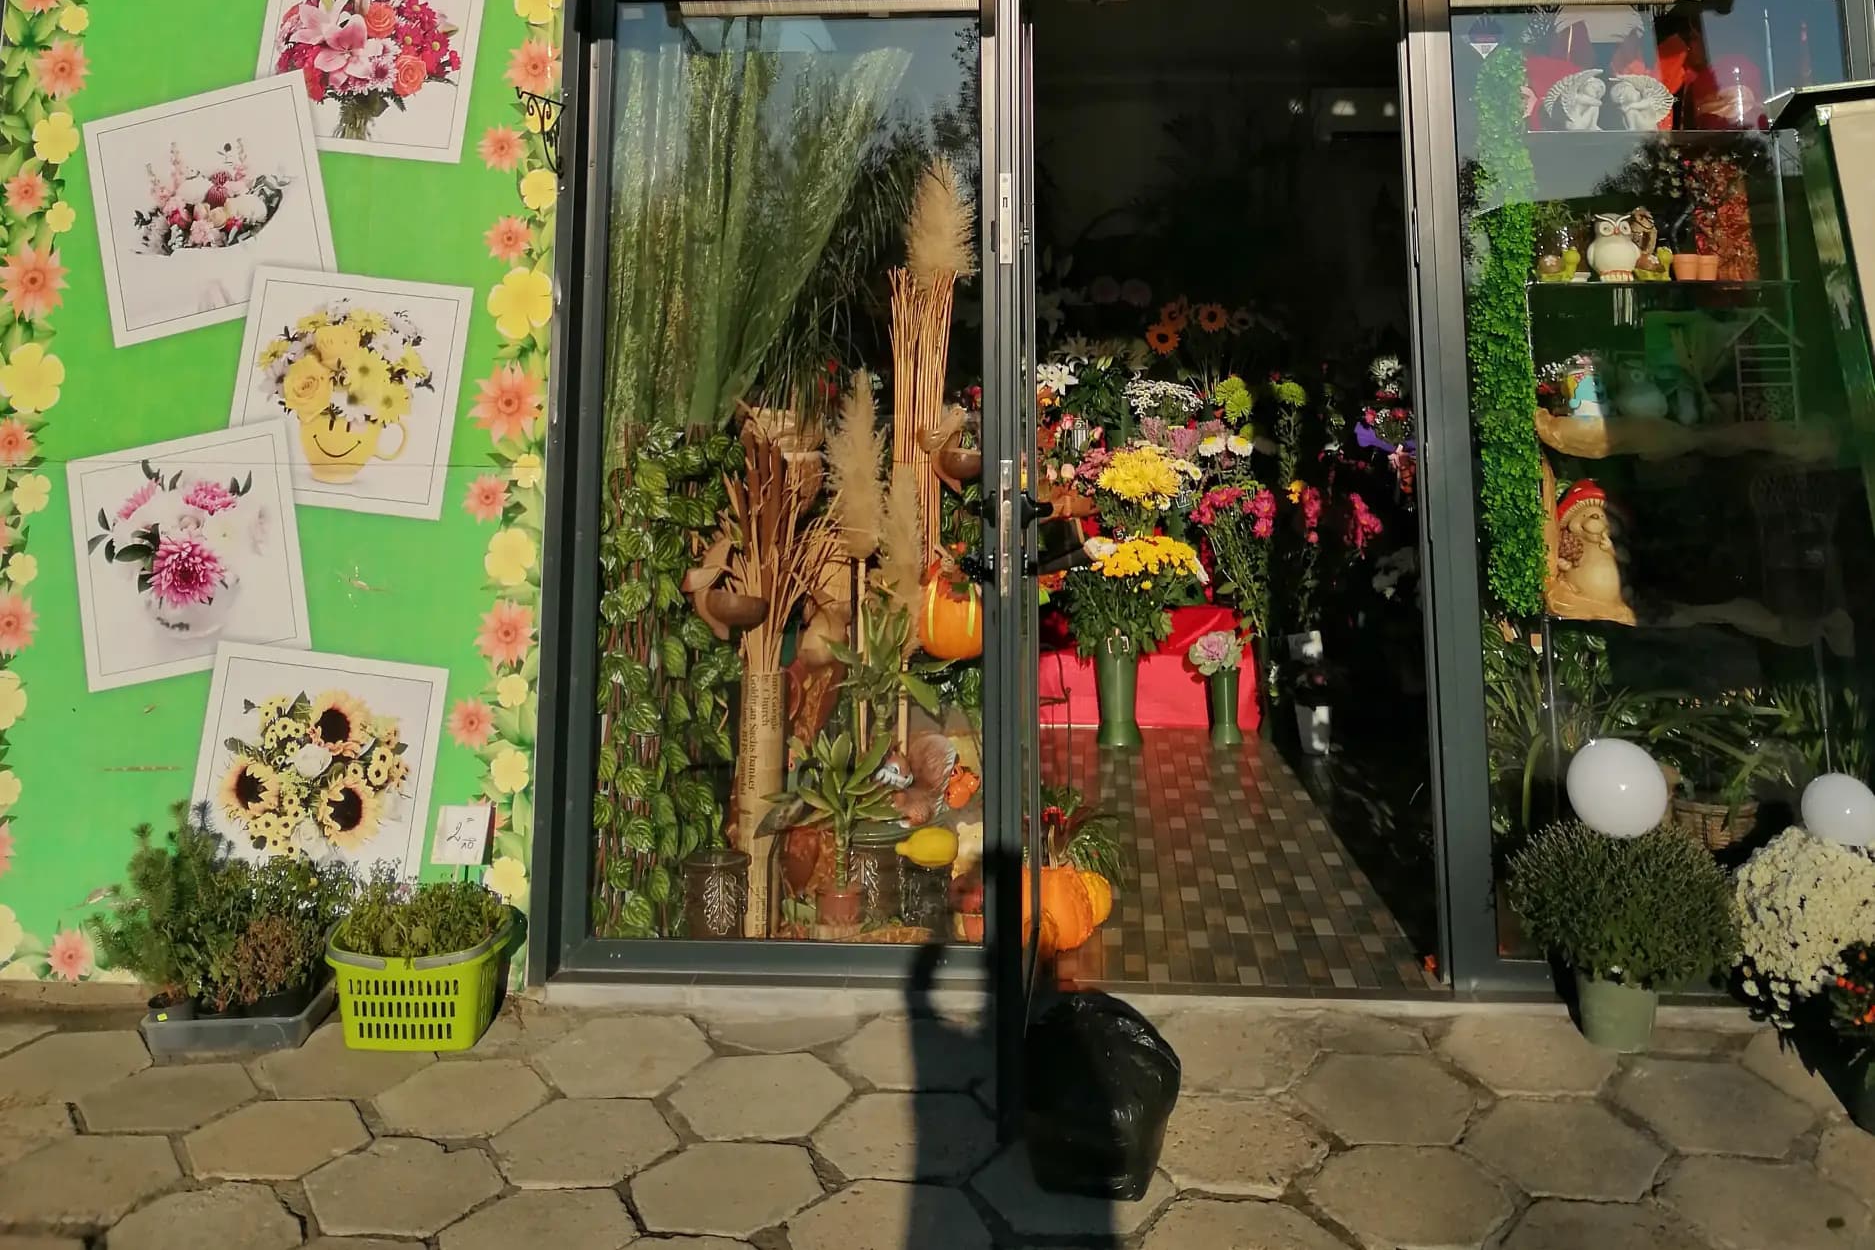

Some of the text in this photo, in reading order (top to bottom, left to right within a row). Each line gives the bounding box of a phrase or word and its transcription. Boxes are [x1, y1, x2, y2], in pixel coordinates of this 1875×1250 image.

[748, 674, 760, 791] Goldman Sachs banker
